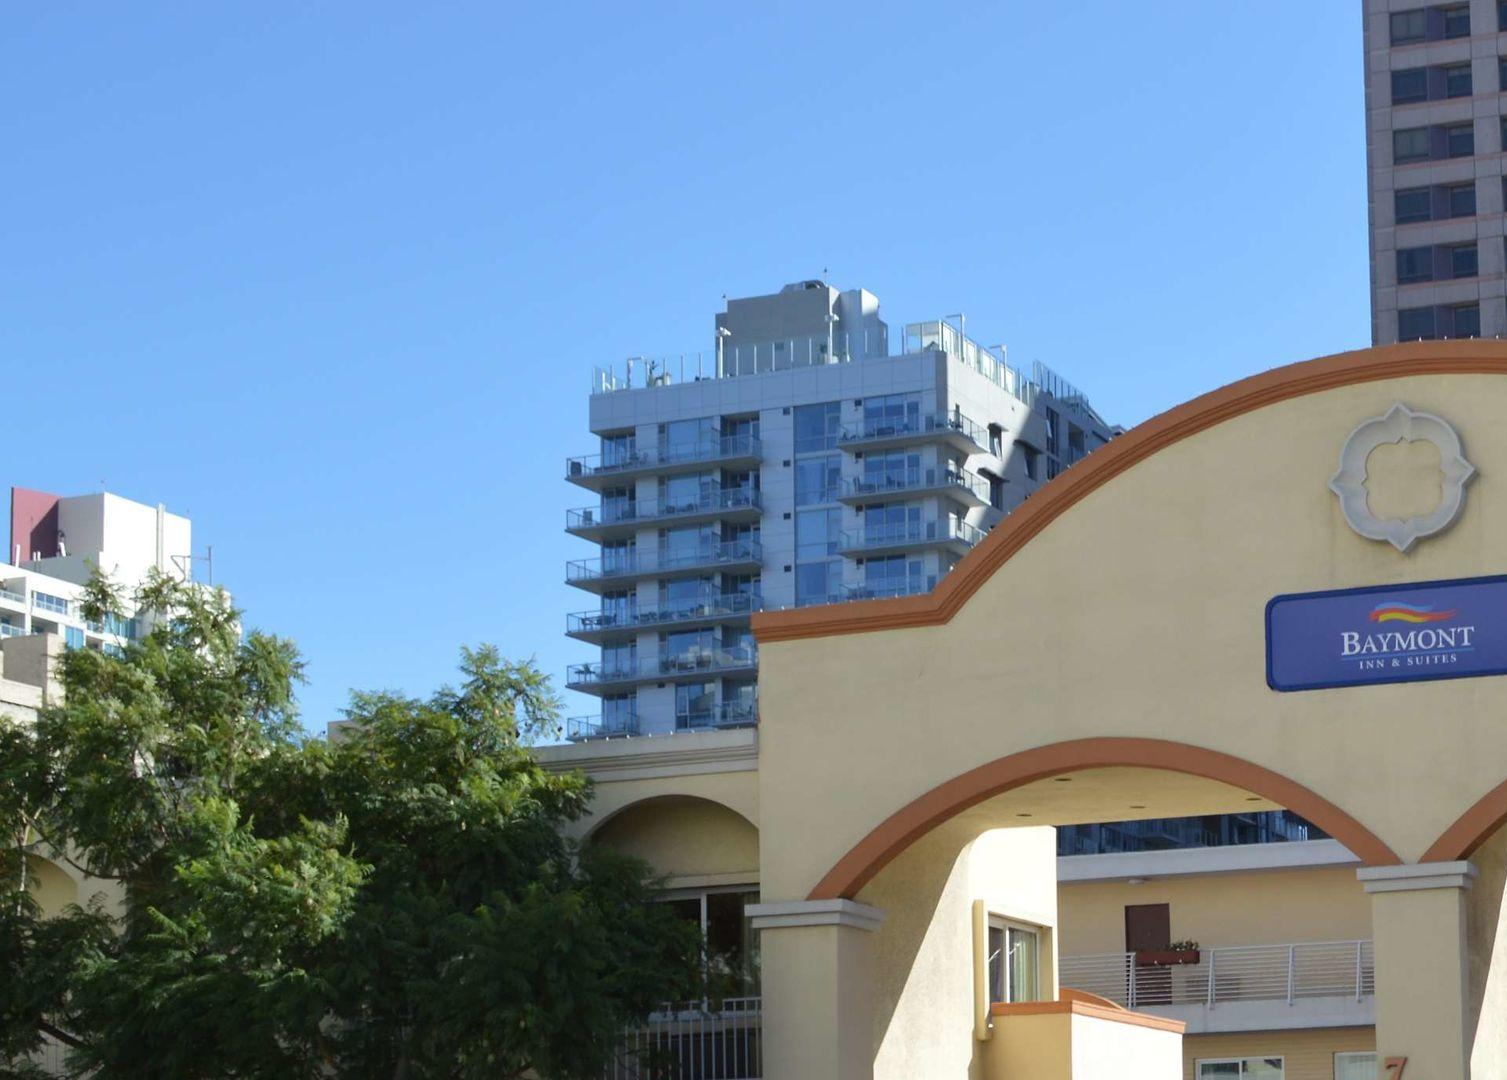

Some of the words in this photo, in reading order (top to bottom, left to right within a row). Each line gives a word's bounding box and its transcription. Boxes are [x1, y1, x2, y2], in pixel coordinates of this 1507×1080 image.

[1340, 625, 1475, 656] BAYMONT
[1359, 659, 1385, 670] INN
[1391, 657, 1400, 667] &
[1406, 653, 1458, 667] SUITES
